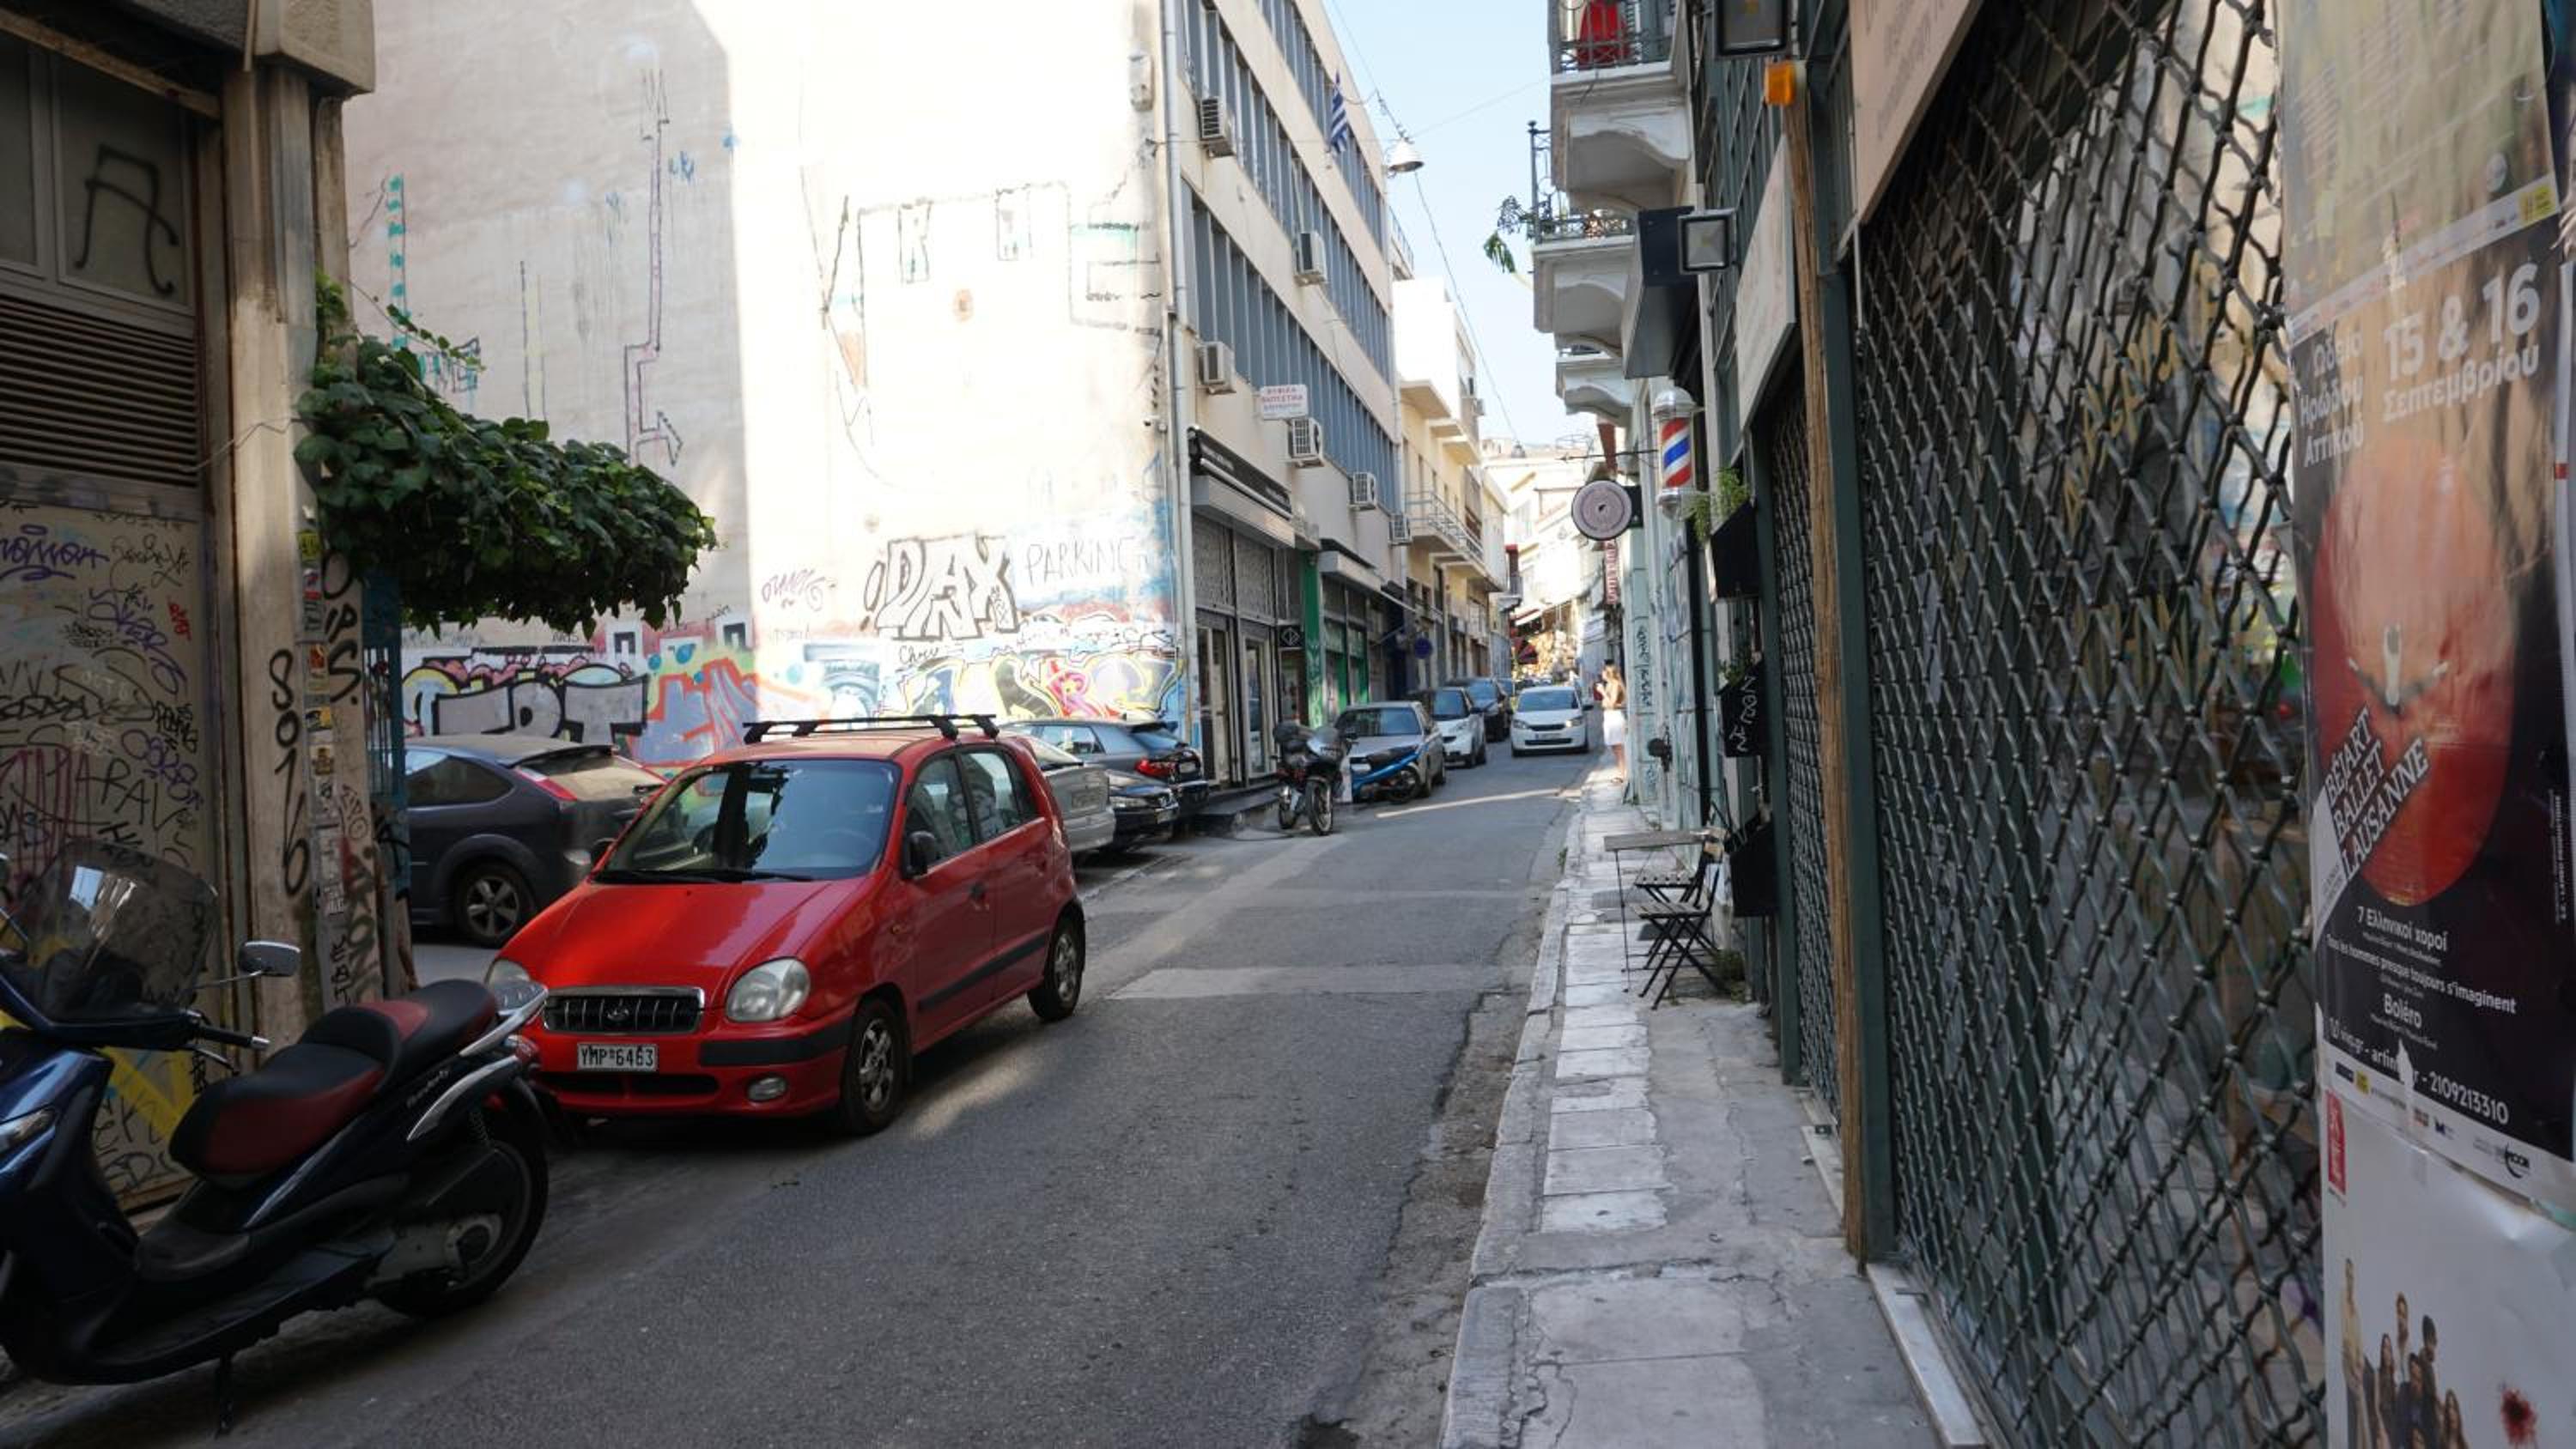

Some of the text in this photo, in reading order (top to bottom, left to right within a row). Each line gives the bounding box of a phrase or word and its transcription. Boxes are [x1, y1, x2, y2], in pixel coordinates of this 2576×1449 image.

[2384, 263, 2541, 381] 15 & 16
[2383, 344, 2539, 424] Σεπτεμβρίου
[2332, 739, 2385, 844] BALLET
[2341, 737, 2430, 881] LAUSANNE
[2384, 992, 2423, 1029] Boléro
[2446, 980, 2517, 1015] s'imaginent
[2430, 1072, 2510, 1125] 2109213310
